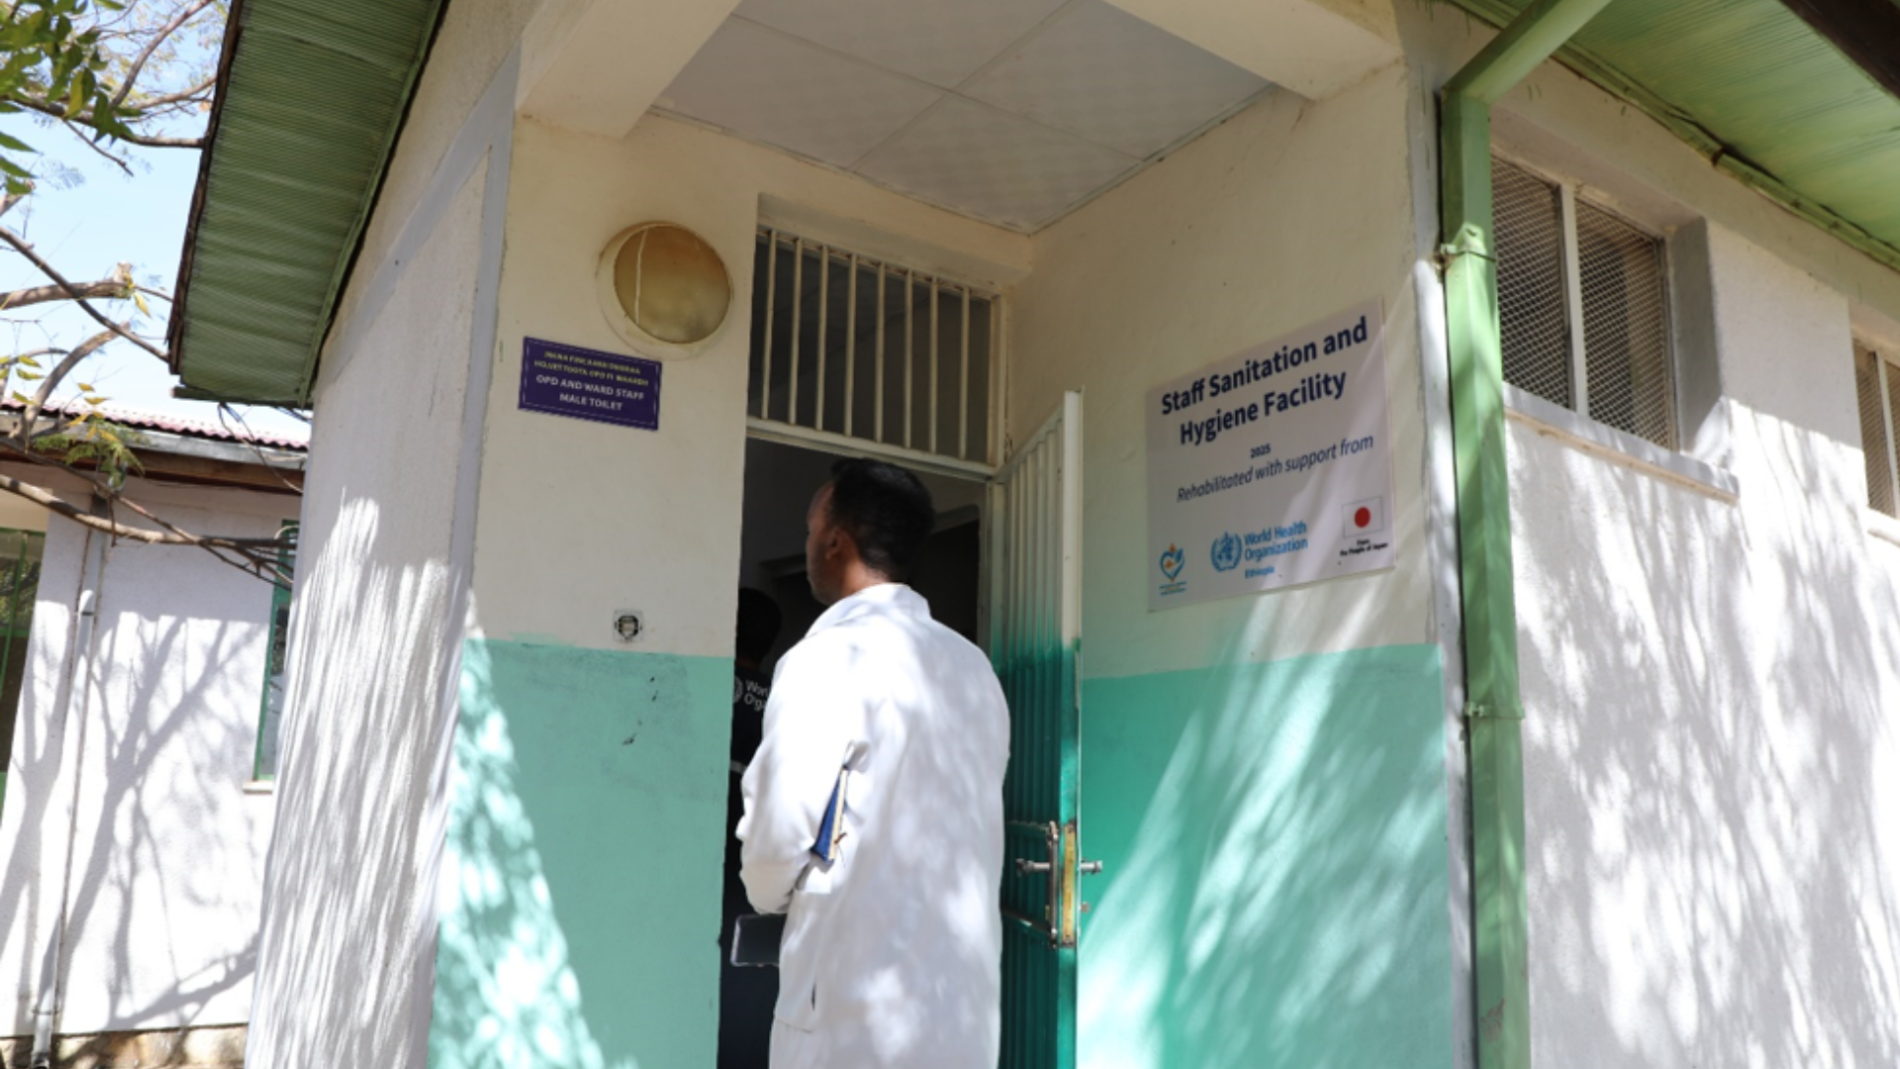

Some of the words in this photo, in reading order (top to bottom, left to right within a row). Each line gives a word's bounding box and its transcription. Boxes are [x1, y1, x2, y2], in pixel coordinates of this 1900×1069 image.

[1162, 378, 1206, 415] Staff
[1209, 340, 1318, 398] Sanitation
[1323, 315, 1368, 355] and
[536, 374, 559, 385] OPD
[560, 379, 583, 390] AND
[584, 383, 614, 395] WARD
[616, 388, 645, 400] STAFF
[559, 393, 587, 406] MALE
[589, 398, 623, 411] TOILET
[1180, 402, 1259, 446] Hygiene
[1263, 371, 1346, 417] Facility
[1177, 467, 1253, 502] Rehabilitated
[1255, 459, 1283, 480] with
[1285, 446, 1337, 472] support
[1338, 434, 1373, 455] from
[1244, 527, 1272, 546] World
[1274, 520, 1307, 539] Health
[1245, 537, 1308, 562] Organization
[1245, 565, 1275, 579] Ethiopia
